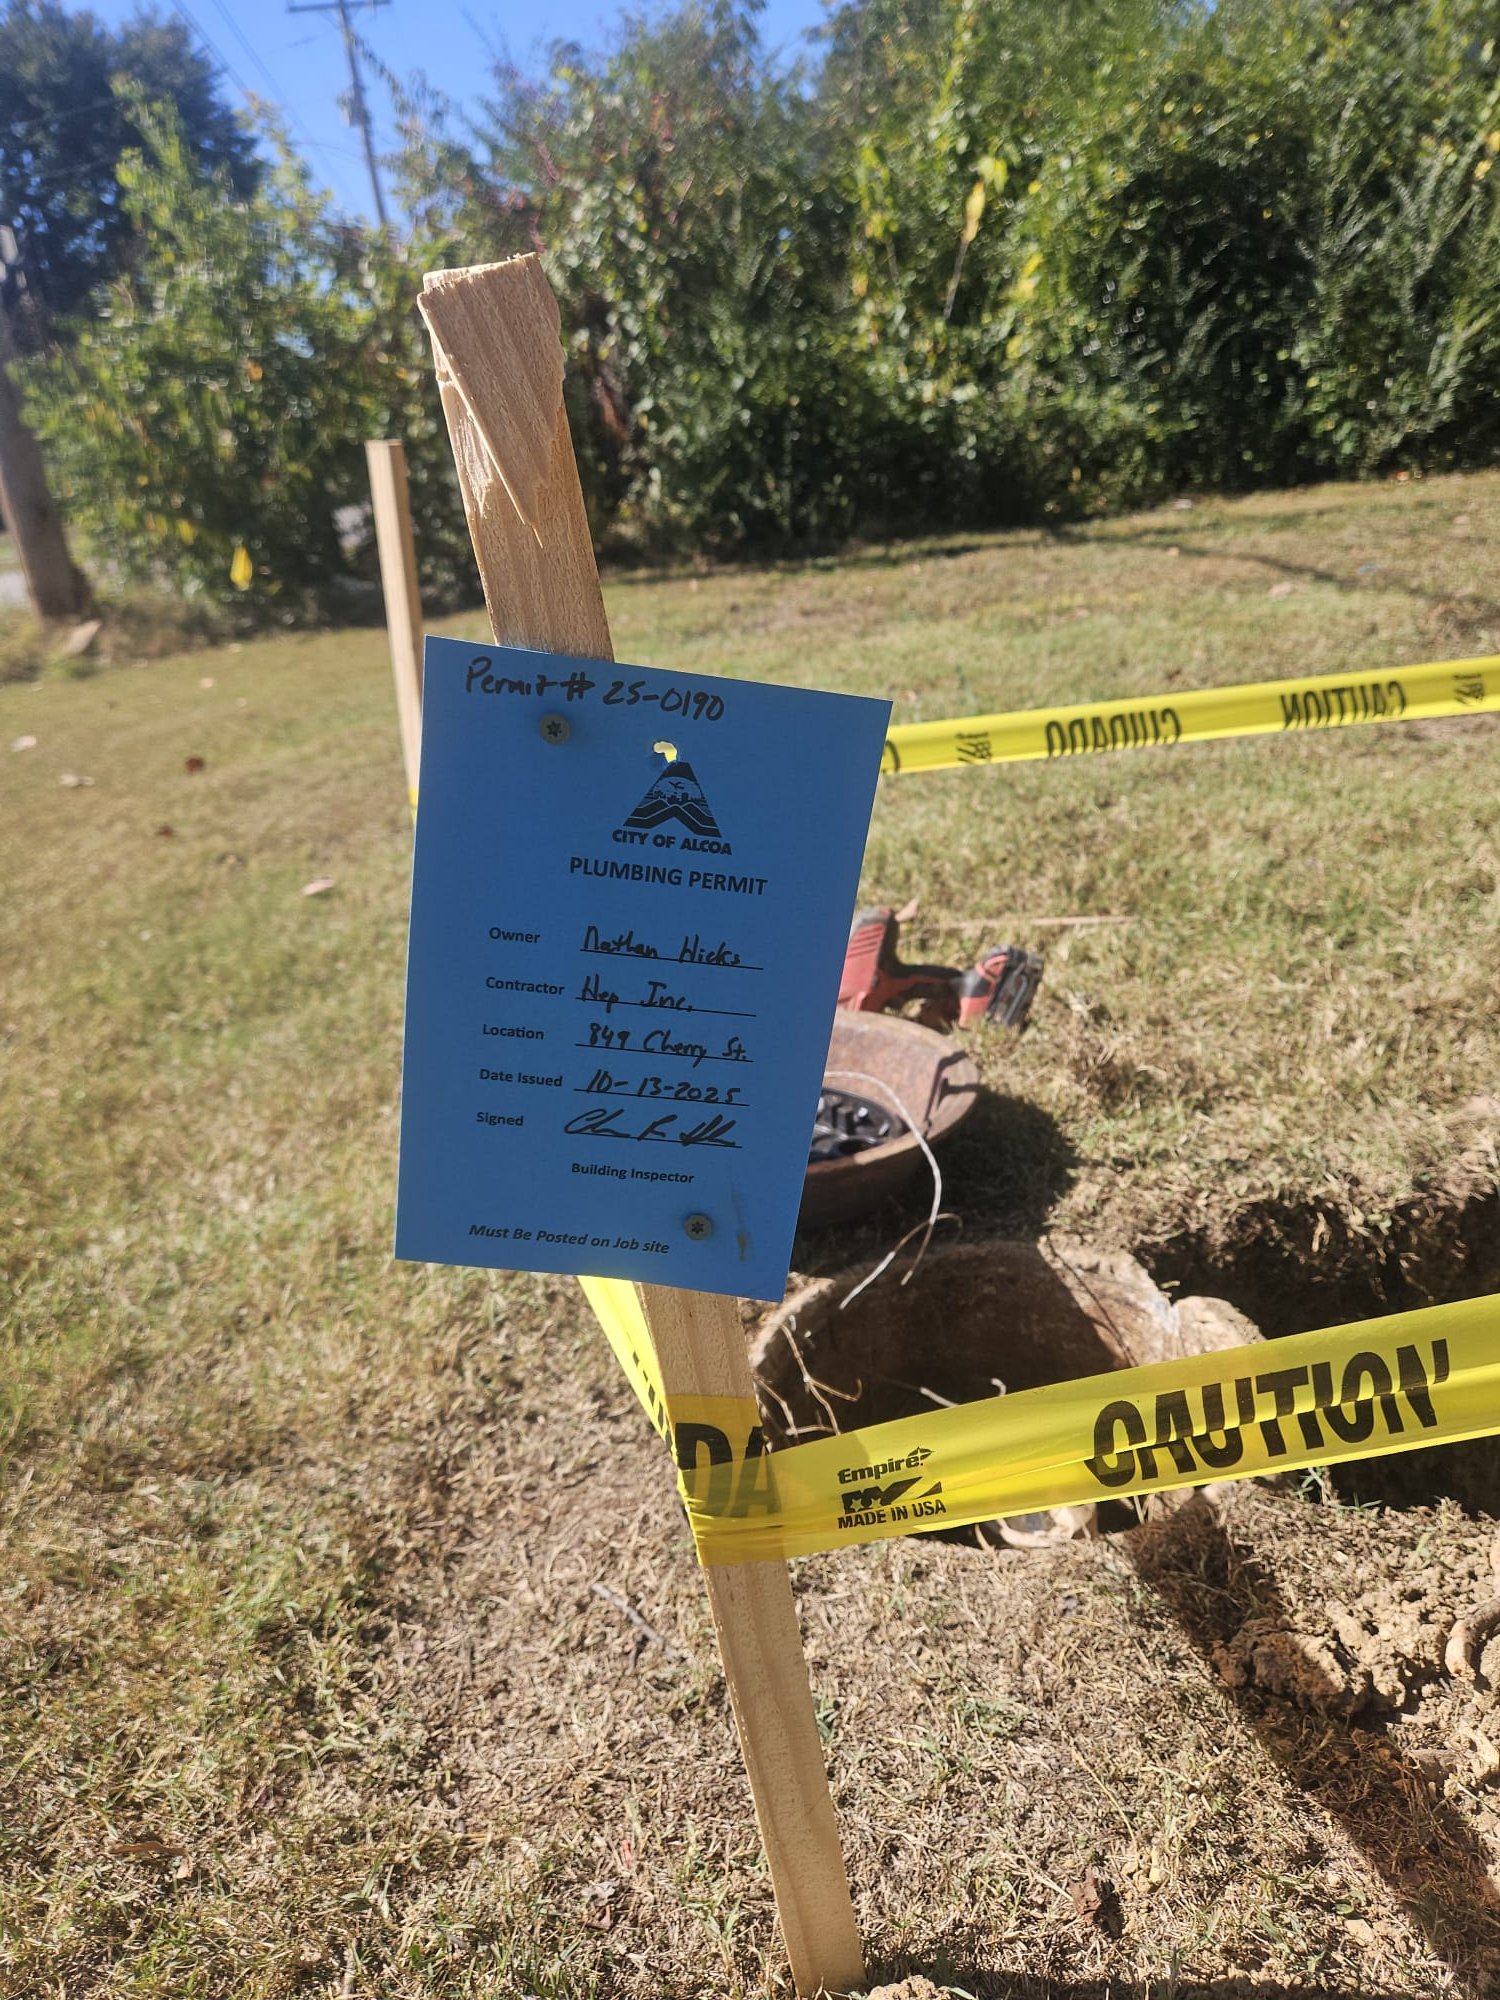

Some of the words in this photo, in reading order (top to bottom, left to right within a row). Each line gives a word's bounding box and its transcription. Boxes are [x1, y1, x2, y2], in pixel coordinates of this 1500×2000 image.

[466, 656, 557, 697] Permit
[612, 829, 648, 845] CITY
[652, 834, 676, 849] OF
[680, 838, 732, 856] ALCOA
[569, 856, 683, 886] PLUMBING
[688, 871, 768, 896] PERMIT
[489, 927, 541, 944] Owner
[485, 976, 565, 996] Contractor
[482, 1023, 545, 1041] Location
[642, 1030, 706, 1068] Cherry
[479, 1068, 513, 1083] Date
[517, 1072, 563, 1088] Issued
[476, 1112, 524, 1128] Signed
[571, 1163, 627, 1180] Building
[630, 1168, 695, 1184] Inspector
[468, 1224, 509, 1239] Must
[512, 1228, 532, 1241] Be
[536, 1229, 588, 1246] Posted
[590, 1236, 609, 1248] on
[612, 1236, 640, 1251] Job
[642, 1239, 670, 1255] site
[1084, 1338, 1451, 1487] CAUTION
[837, 1509, 887, 1529] MADE
[890, 1505, 908, 1522] IN
[911, 1499, 946, 1518] USA
